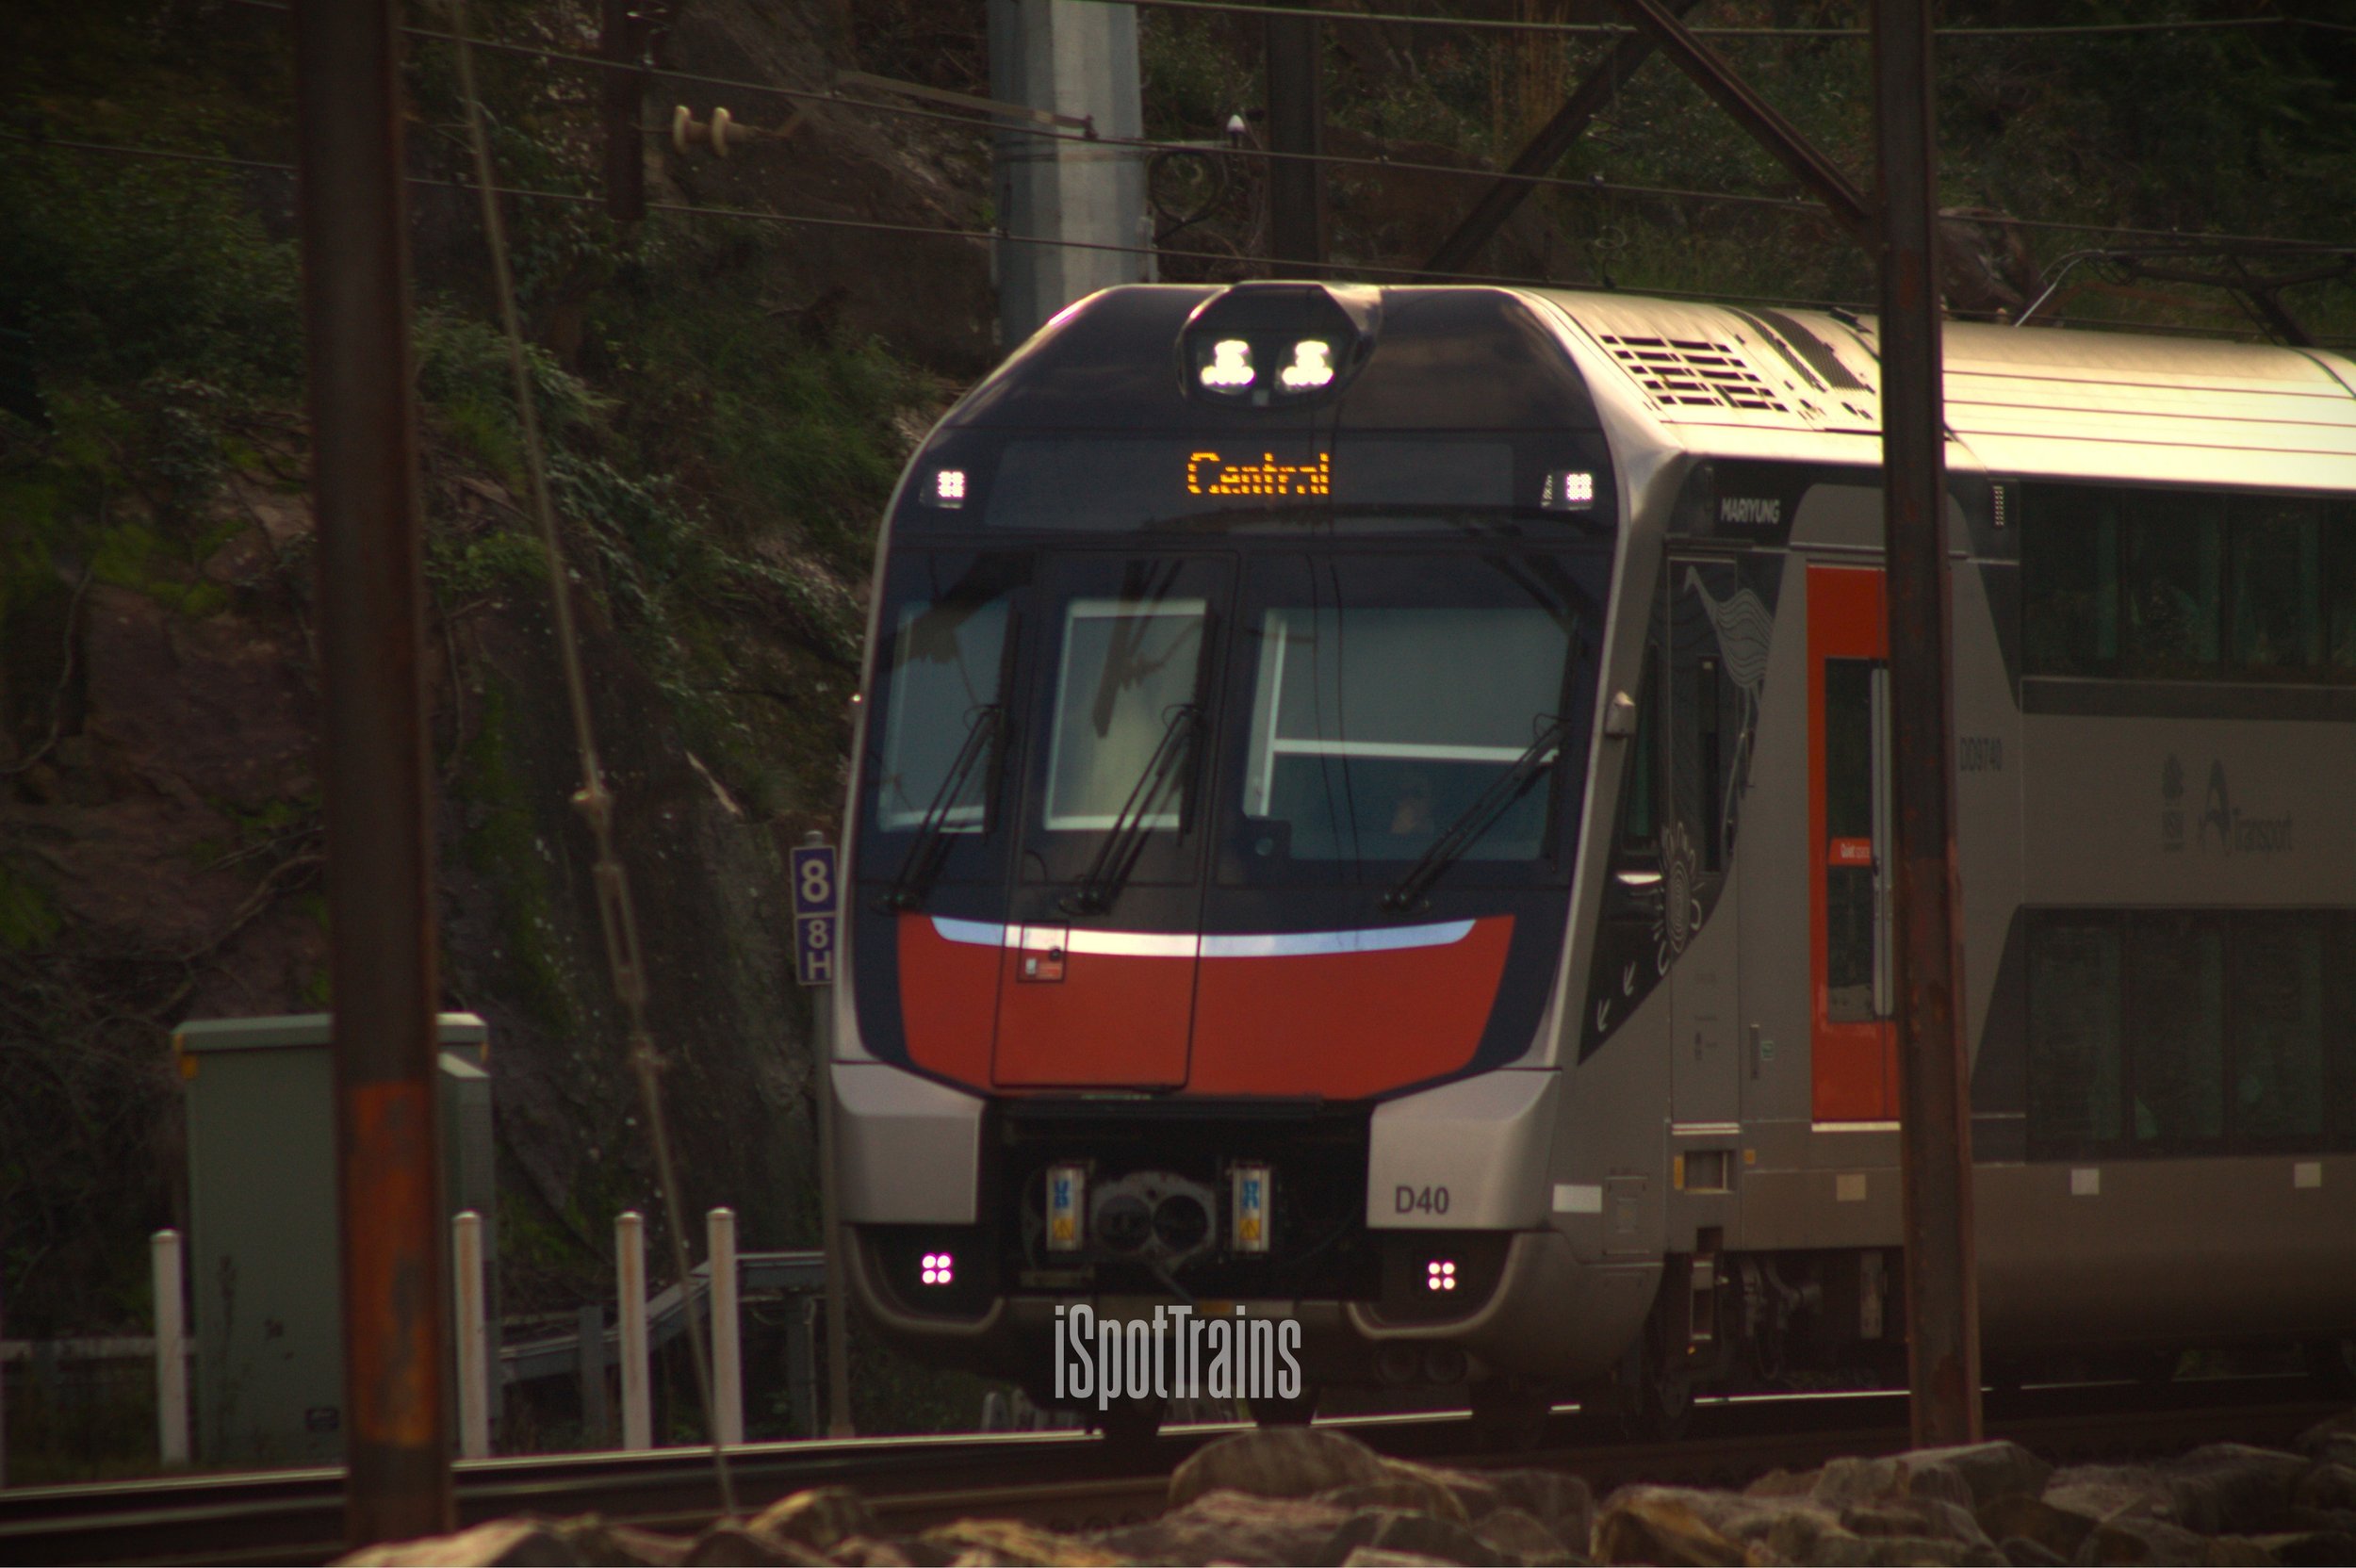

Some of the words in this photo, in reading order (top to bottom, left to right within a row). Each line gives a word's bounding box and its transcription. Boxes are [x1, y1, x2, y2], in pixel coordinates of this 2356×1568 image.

[1187, 452, 1329, 494] Central
[1721, 498, 1780, 525] MARIYUNG
[801, 858, 830, 904] 8
[808, 919, 829, 949] 8
[808, 951, 830, 980] H
[1396, 1185, 1449, 1215] D40
